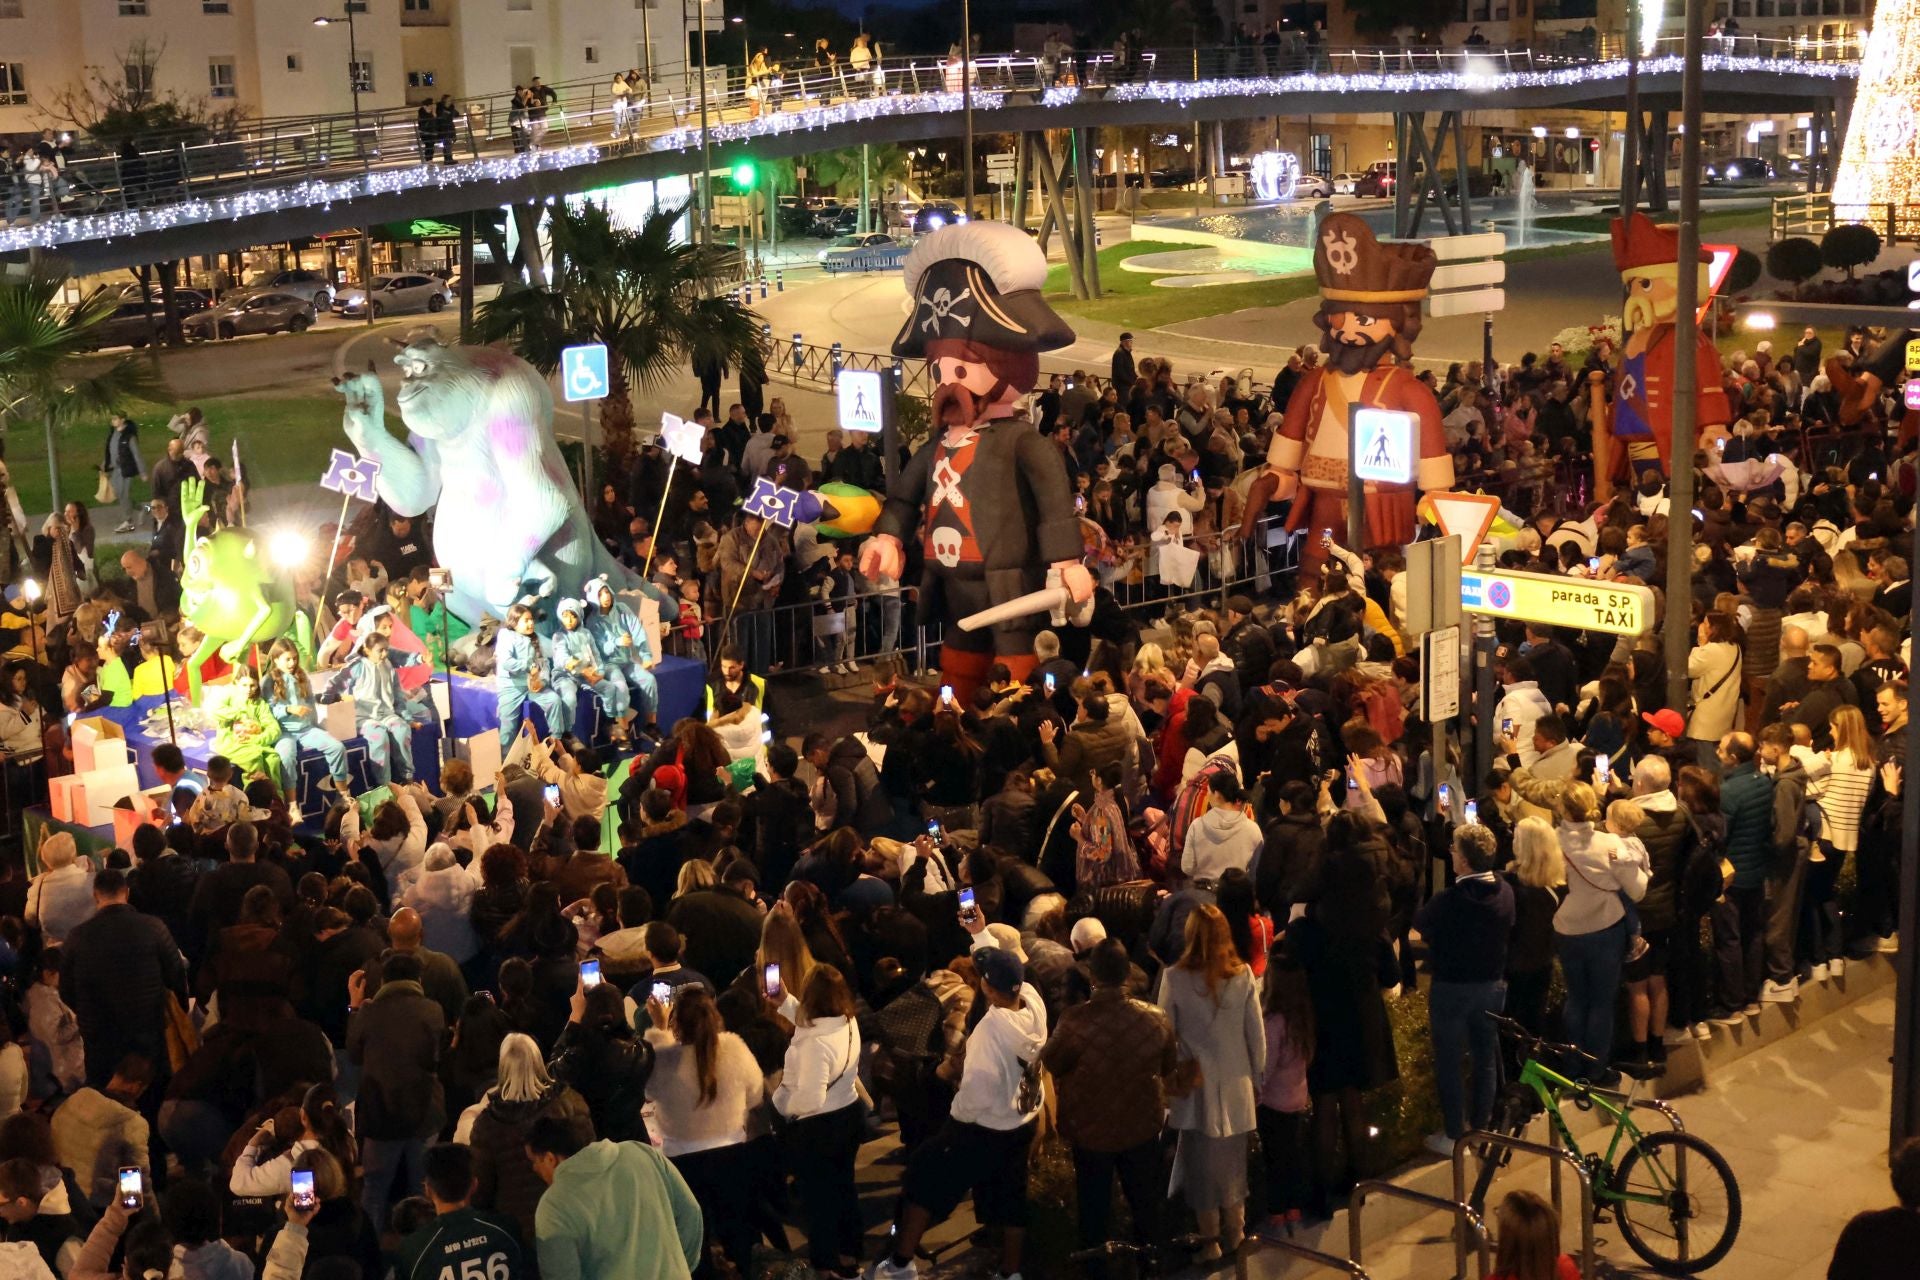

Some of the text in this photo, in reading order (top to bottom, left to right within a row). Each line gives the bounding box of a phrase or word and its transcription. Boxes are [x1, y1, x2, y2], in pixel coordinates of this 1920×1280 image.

[1552, 590, 1633, 609] parada S.P.
[1594, 609, 1634, 628] TAXI
